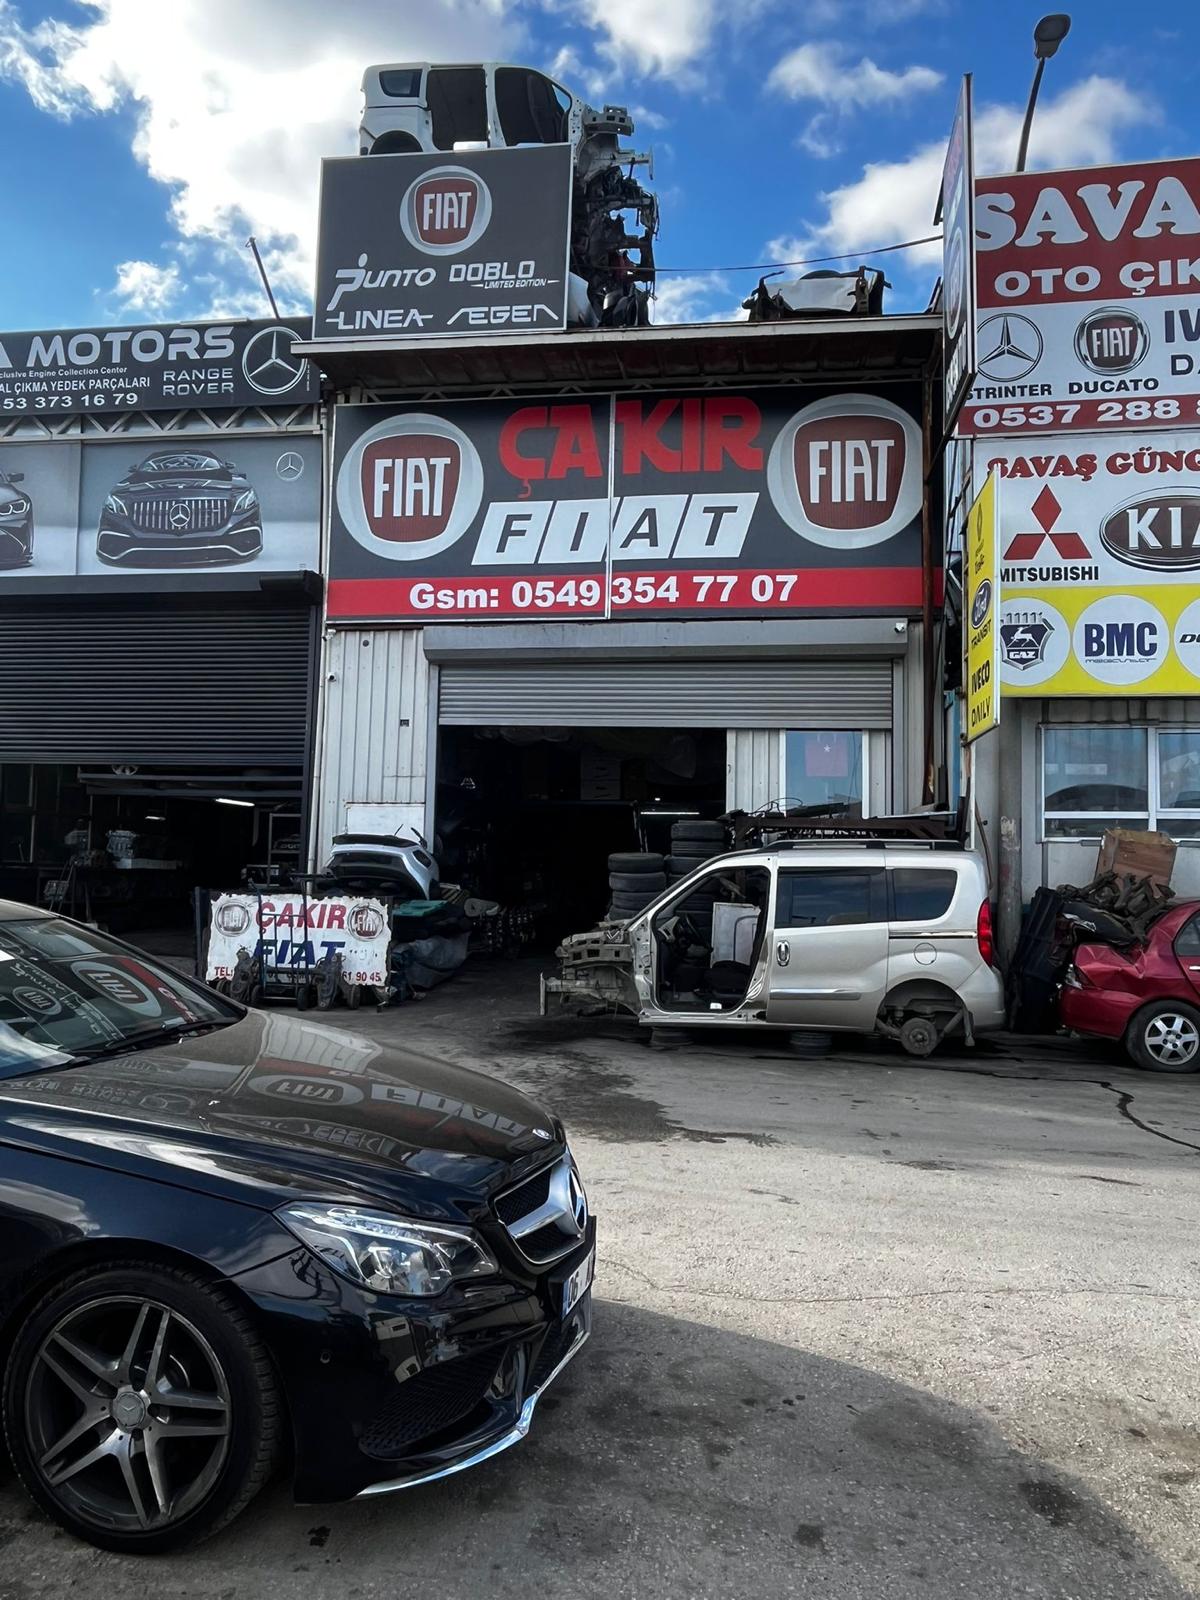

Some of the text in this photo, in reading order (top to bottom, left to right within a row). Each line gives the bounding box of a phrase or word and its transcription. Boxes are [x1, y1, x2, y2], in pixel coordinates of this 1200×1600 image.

[423, 191, 472, 231] FIAT
[449, 260, 536, 282] DOBLO
[484, 278, 547, 289] LIMITED EDITION
[994, 265, 1101, 298] OTO
[1119, 257, 1200, 295] ÇIK
[326, 308, 434, 331] LINEA
[26, 325, 235, 368] MOTORS
[1092, 326, 1133, 359] FIAT
[14, 381, 48, 396] ÇIKMA
[50, 379, 86, 392] YEDEK
[88, 377, 151, 391] PARÇALARI
[29, 370, 57, 379] Engine
[58, 366, 99, 376] Collection
[100, 366, 128, 375] Center
[163, 367, 234, 382] RANGE
[1068, 378, 1160, 395] DUCATO
[3, 392, 139, 409] 53 373 16 79
[163, 382, 234, 396] ROVER
[973, 404, 1082, 428] 0537
[1096, 399, 1181, 422] 288
[498, 397, 763, 498] ÇAKIR
[809, 438, 896, 504] FIAT
[372, 456, 452, 519] FIAT
[494, 502, 741, 557] FIAT
[1127, 507, 1200, 550] KI
[1000, 565, 1100, 583] MITSUBISHI
[409, 573, 799, 611] Gsm: 0549 354 77 07
[1084, 622, 1158, 657] BMC
[1009, 651, 1036, 659] GAZ
[972, 659, 990, 695] IVECO
[971, 695, 991, 728] DAILY
[256, 901, 347, 935] ÇAKIR
[252, 939, 346, 968] FIAT
[214, 966, 234, 978] TEL:
[355, 971, 368, 982] 90
